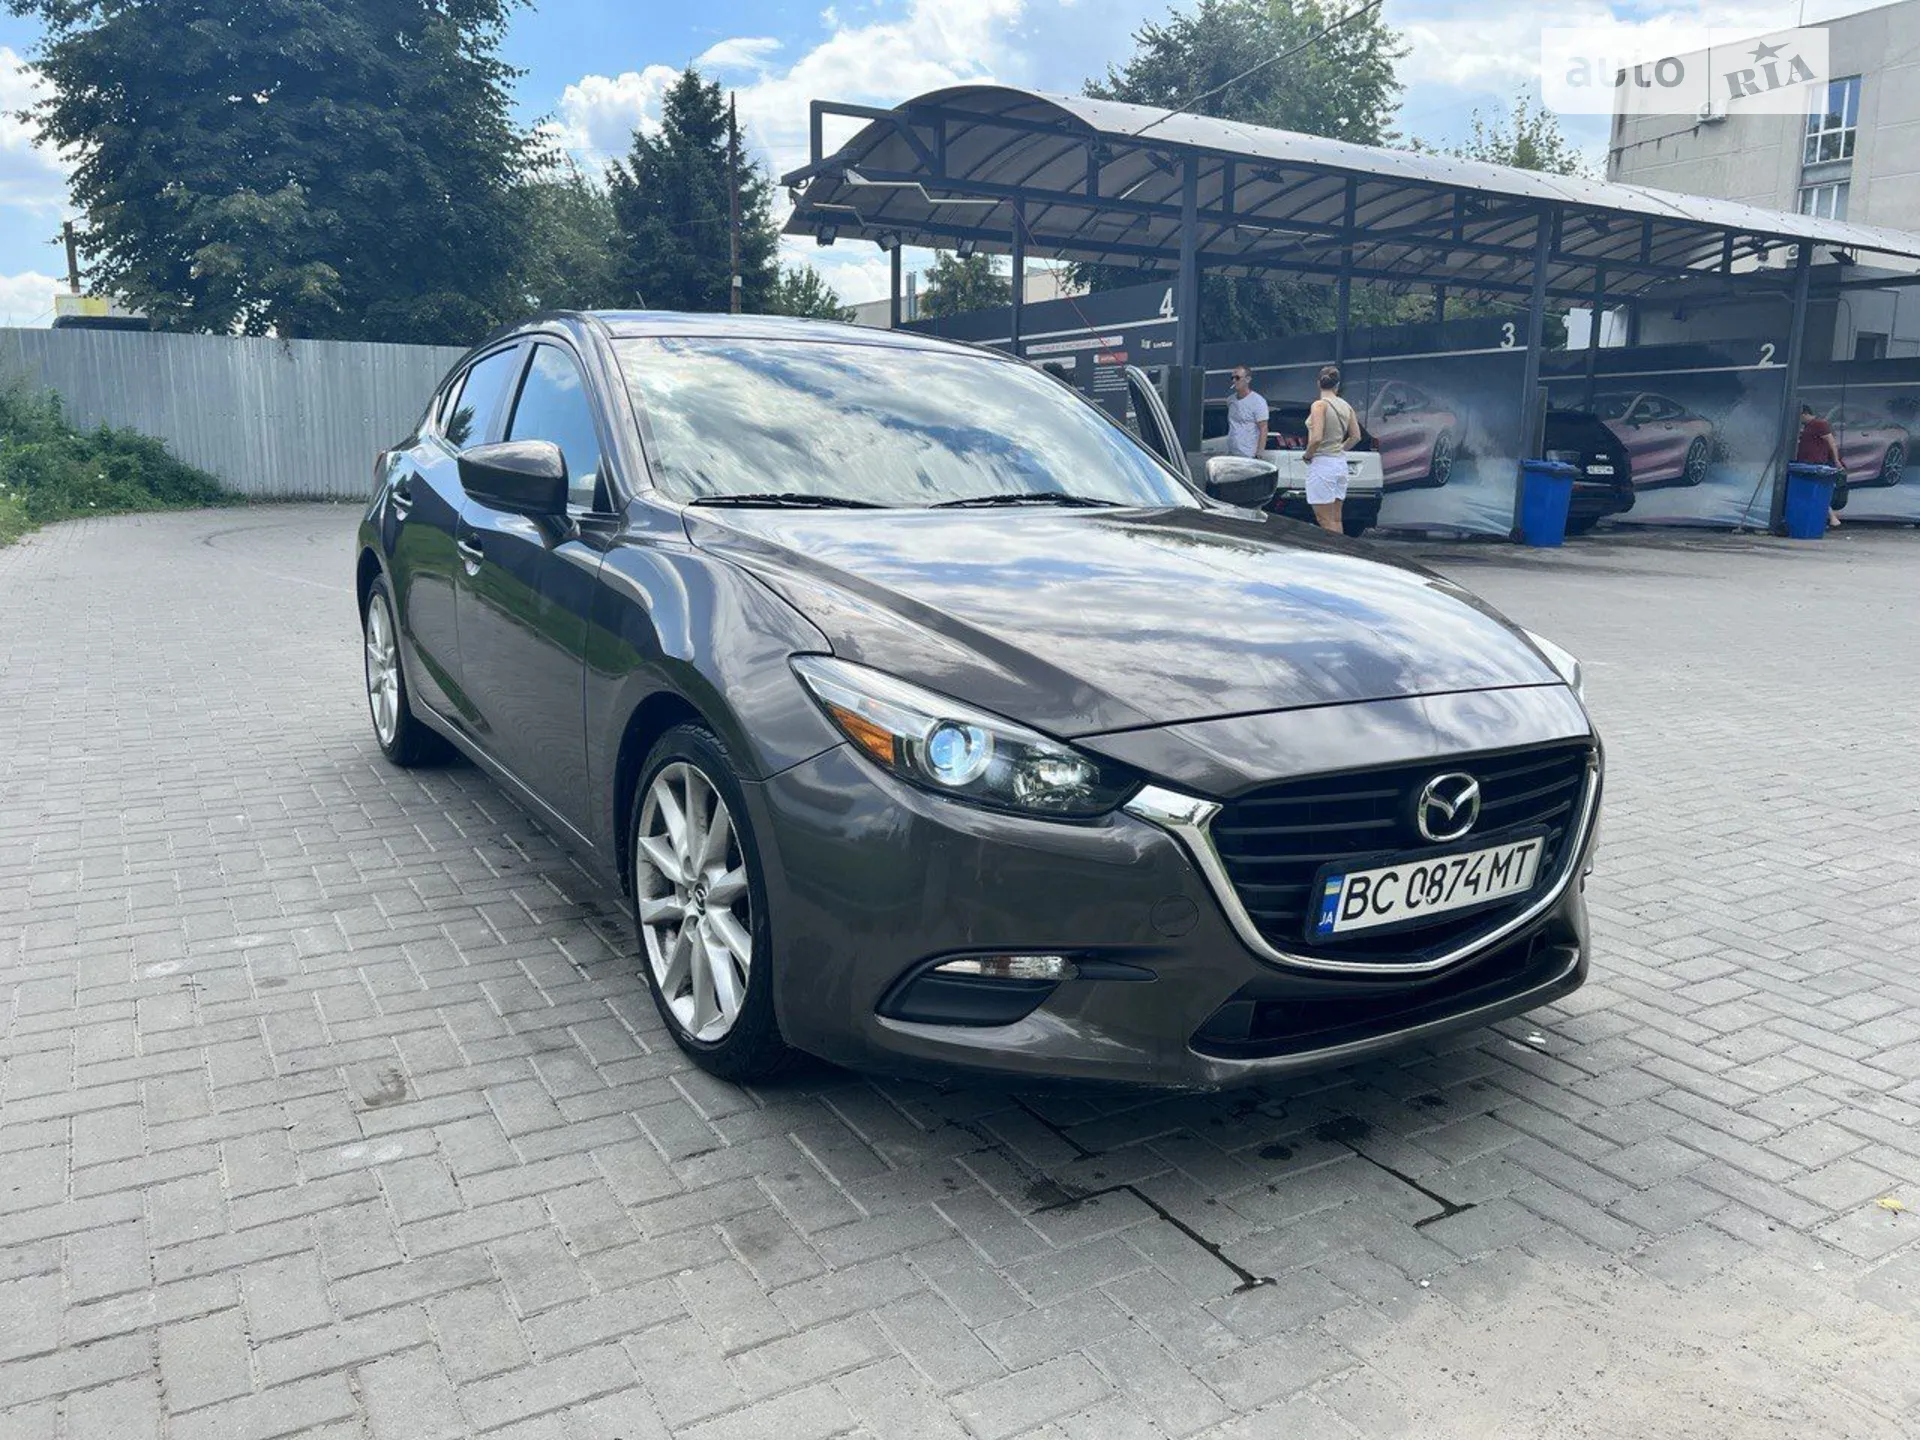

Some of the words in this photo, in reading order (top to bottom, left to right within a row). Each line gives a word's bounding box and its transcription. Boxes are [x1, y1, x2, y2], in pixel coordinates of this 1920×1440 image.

[1158, 287, 1175, 319] 4
[1500, 322, 1516, 348] 3
[1758, 343, 1776, 367] 2
